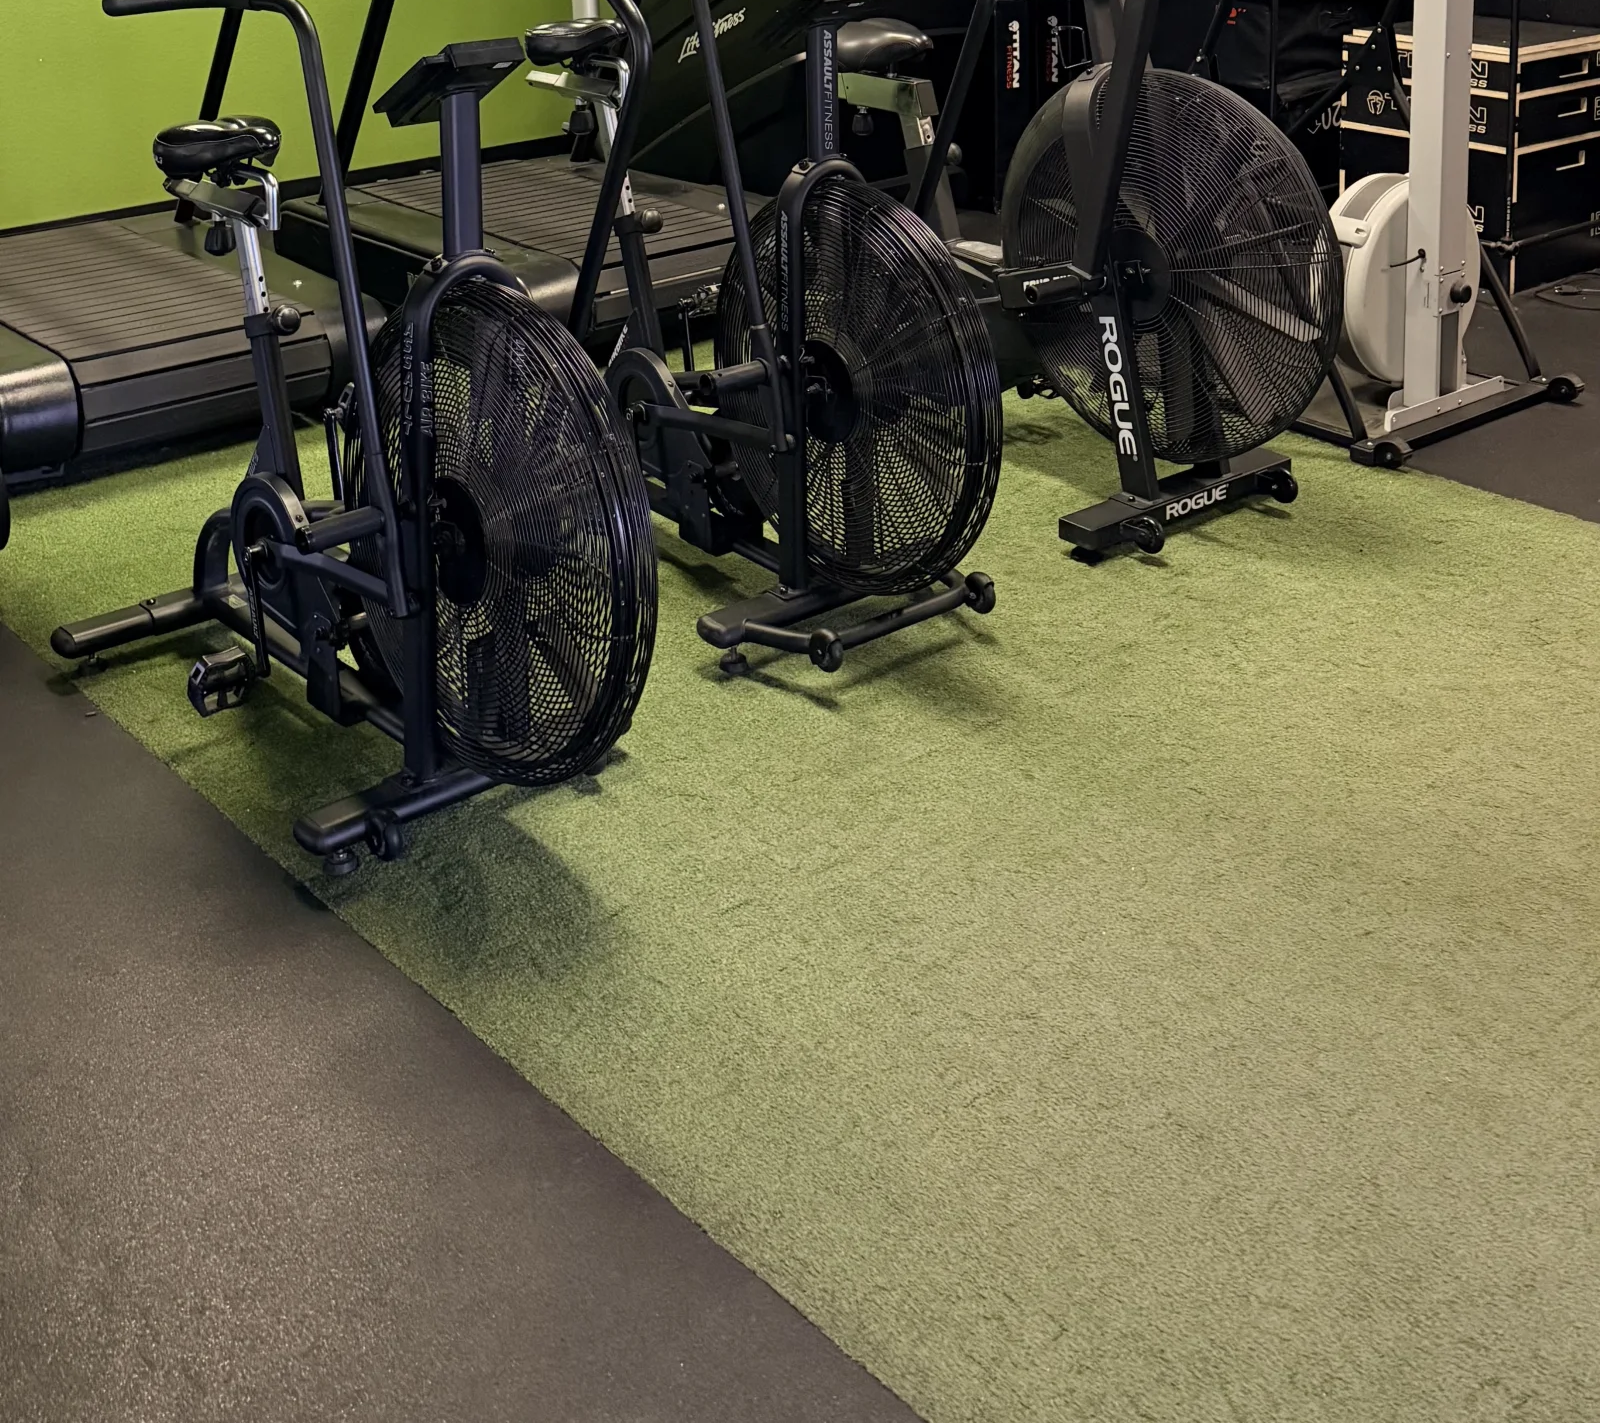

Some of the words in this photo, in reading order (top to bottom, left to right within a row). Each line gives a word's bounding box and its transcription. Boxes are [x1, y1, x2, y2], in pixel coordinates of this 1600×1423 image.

[823, 29, 834, 151] ASSAULTFITNESS
[1012, 29, 1020, 89] TITAN
[780, 209, 789, 333] ASSAULTFITNESS
[1098, 315, 1138, 456] ROGUE
[1164, 484, 1229, 521] ROGUE
